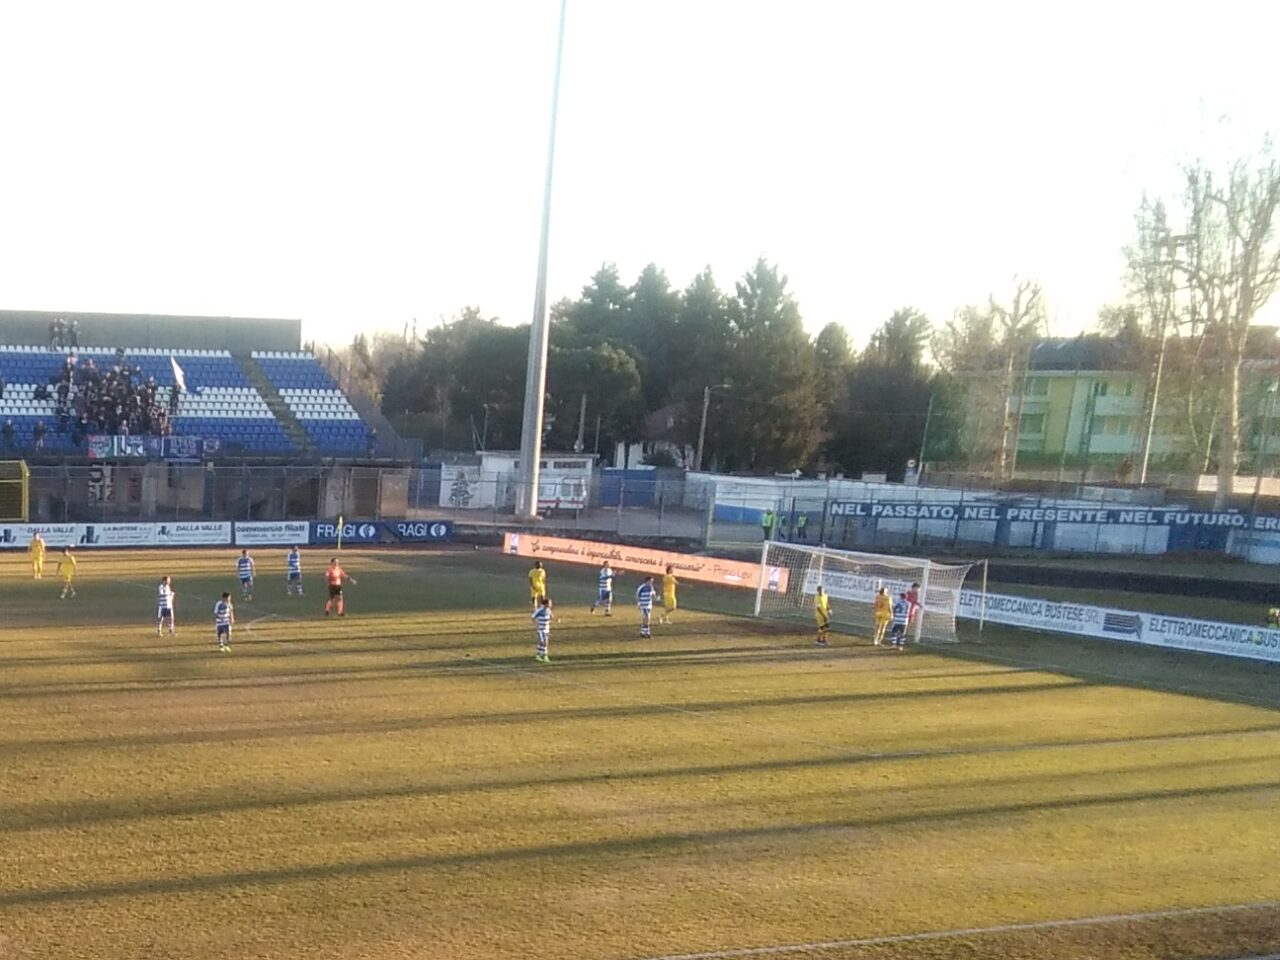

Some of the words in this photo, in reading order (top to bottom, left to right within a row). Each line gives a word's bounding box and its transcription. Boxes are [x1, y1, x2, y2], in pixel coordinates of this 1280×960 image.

[831, 503, 867, 517] NEL
[871, 505, 959, 520] PASSATO,
[964, 507, 1001, 520] NEL
[1119, 511, 1158, 524] NEL
